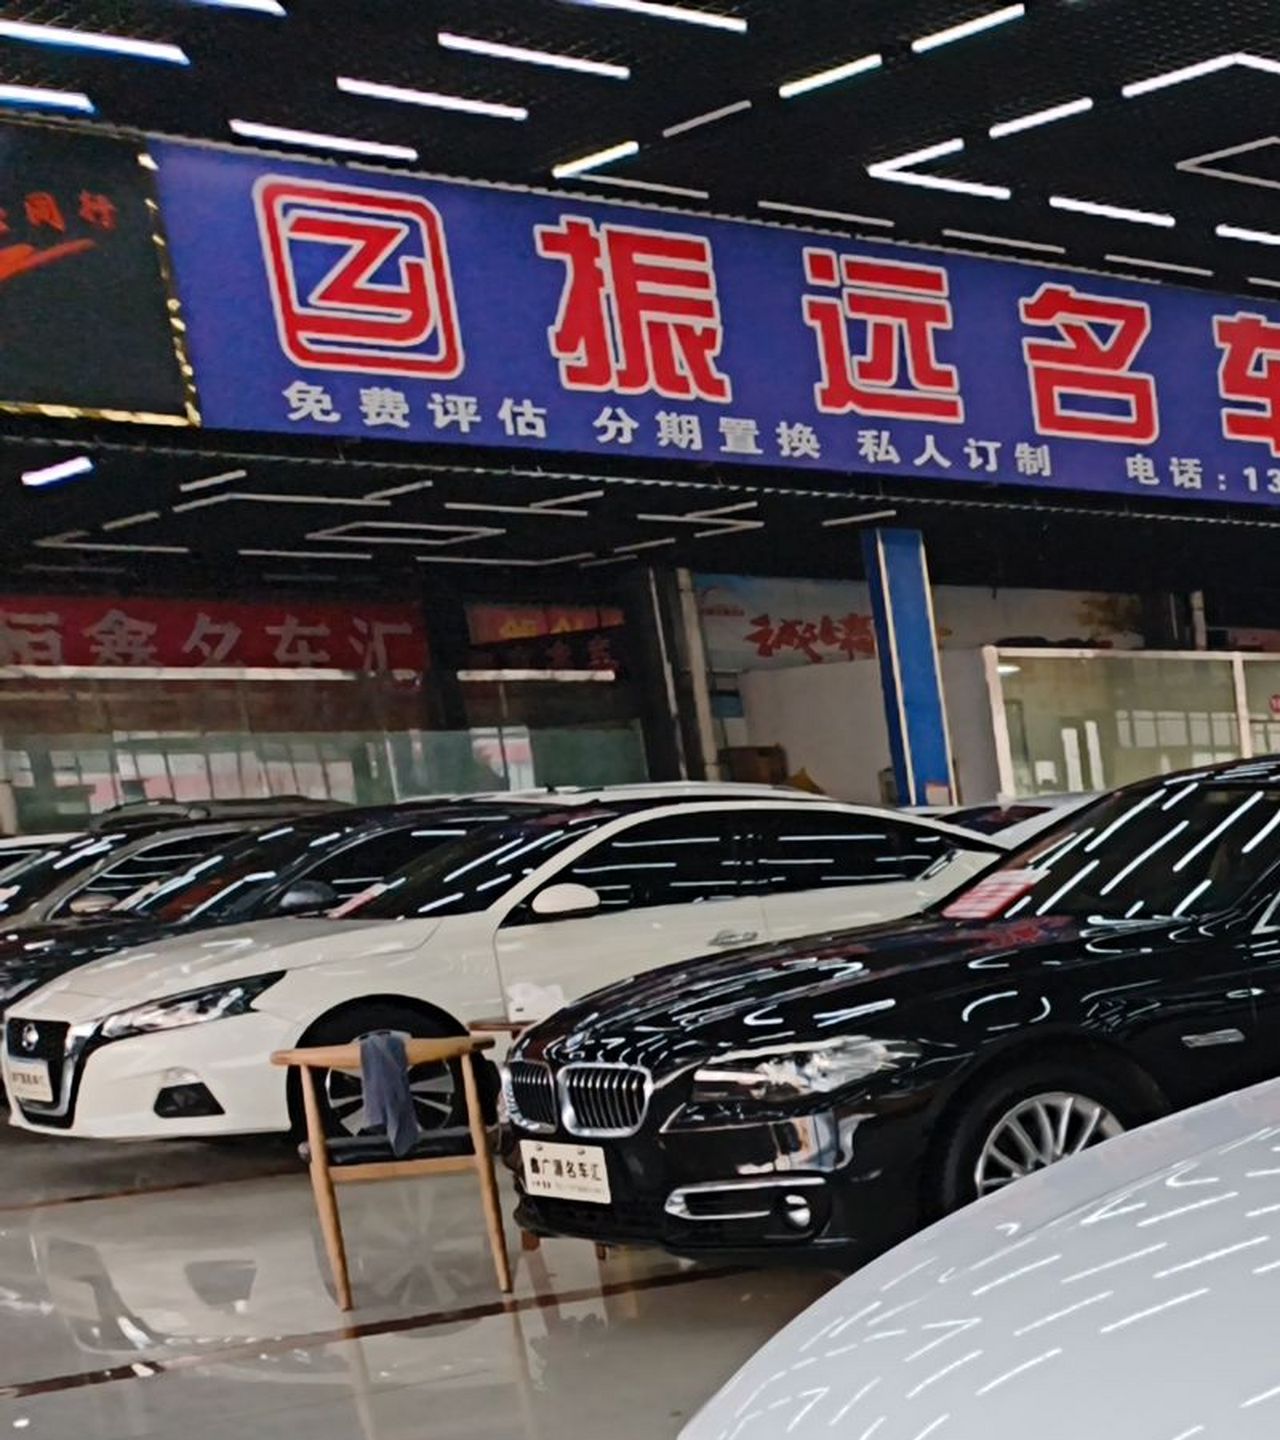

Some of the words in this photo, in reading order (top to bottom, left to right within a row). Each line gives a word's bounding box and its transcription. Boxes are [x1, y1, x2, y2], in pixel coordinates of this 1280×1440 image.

[282, 380, 548, 440] 免费评估
[592, 406, 821, 459] 分期置换
[857, 428, 1052, 477] 私人订制
